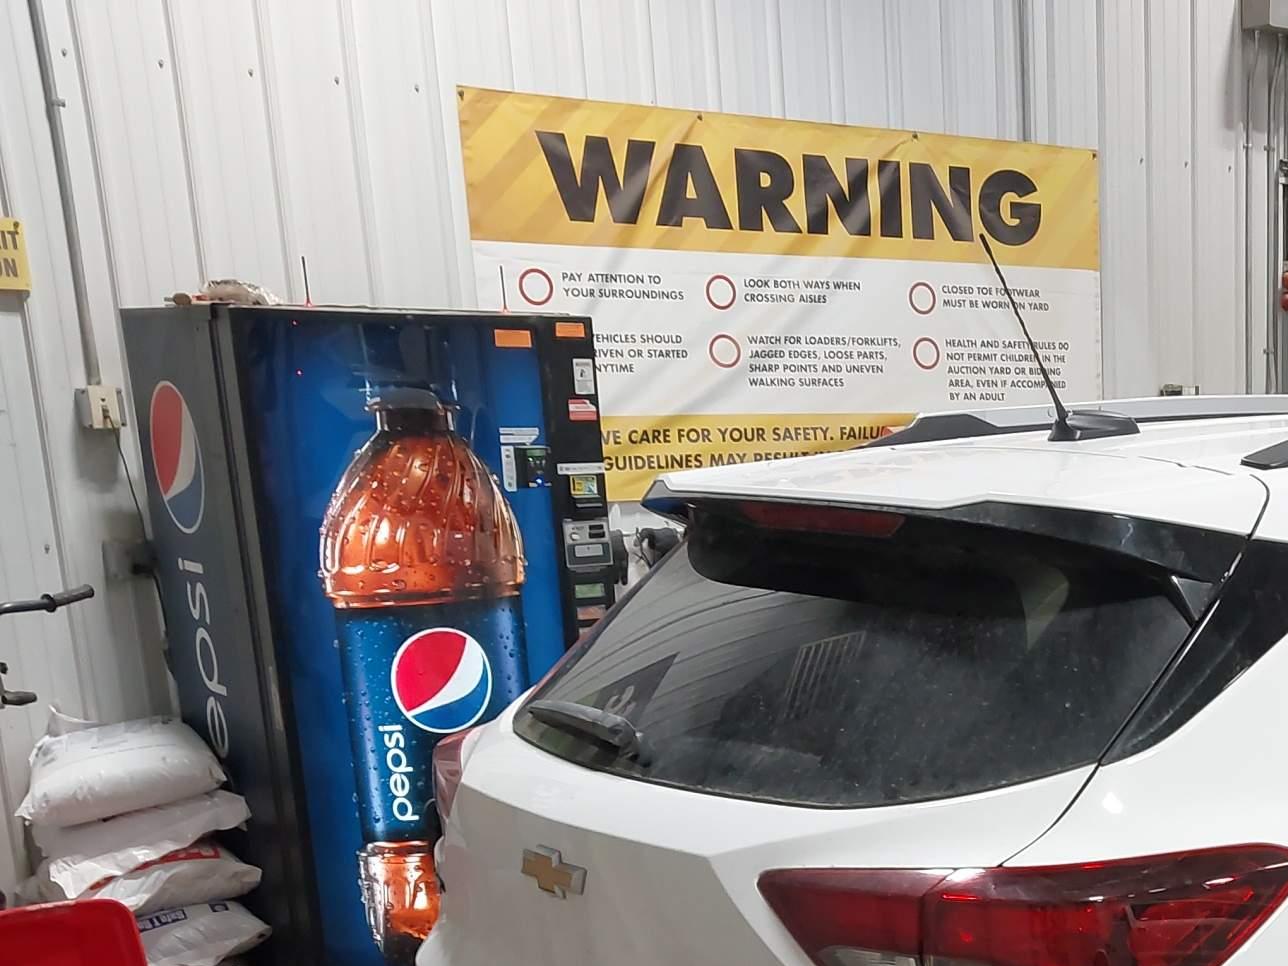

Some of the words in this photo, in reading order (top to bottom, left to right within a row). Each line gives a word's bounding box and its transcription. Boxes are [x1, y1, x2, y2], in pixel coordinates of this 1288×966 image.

[535, 130, 1043, 247] WARNING
[0, 230, 18, 250] IT
[562, 272, 583, 282] PAY
[588, 273, 645, 284] ATTENTION
[647, 275, 662, 285] TO
[743, 278, 770, 289] LOOK
[773, 279, 800, 289] BOTH
[802, 280, 831, 290] WAYS
[833, 281, 861, 291] WHEN
[563, 287, 596, 298] YOUR
[598, 288, 685, 300] SURROUNDINGS
[941, 285, 974, 295] CLOSED
[977, 286, 993, 296] TOE
[743, 293, 795, 304] CROSSING
[799, 294, 828, 304] AISLES
[942, 299, 967, 308] MUST
[969, 300, 979, 309] BE
[982, 300, 1010, 310] WORN
[1012, 301, 1025, 311] ON
[1028, 302, 1049, 311] YARD
[640, 334, 682, 344] SHOULD
[747, 336, 781, 345] WATCH
[784, 336, 802, 345] FOR
[804, 336, 901, 348] LOADERS/FORKLIFTS,
[945, 339, 977, 348] HEALTH
[980, 339, 999, 349] AND
[1001, 340, 1030, 350] SAFETY
[1032, 341, 1056, 350] RULES
[1058, 342, 1069, 351] DO
[594, 348, 624, 358] RIVEN
[627, 349, 644, 358] OR
[647, 349, 688, 359] STARTED
[749, 350, 785, 359] JAGGED
[788, 350, 821, 361] EDGES,
[824, 350, 854, 360] LOOSE
[857, 350, 888, 361] PARTS,
[946, 352, 965, 361] NOT
[967, 353, 997, 362] PERMIT
[1042, 355, 1051, 363] IN
[1053, 355, 1066, 364] THE
[594, 363, 635, 373] NYTIME
[749, 364, 780, 373] SHARP
[783, 364, 818, 373] POINTS
[821, 364, 843, 373] AND
[845, 364, 884, 374] UNEVEN
[947, 366, 986, 375] AUCTION
[988, 366, 1011, 375] YARD
[1014, 367, 1026, 376] OR
[1028, 367, 1061, 377] BIDING
[748, 377, 796, 387] WALKING
[798, 377, 845, 387] SURFACES
[948, 379, 973, 389] AREA,
[976, 379, 998, 388] EVEN
[1000, 379, 1007, 388] IF
[1010, 379, 1066, 389] ACCOMPNIED
[949, 392, 960, 401] BY
[963, 392, 976, 401] AN
[979, 392, 1005, 401] ADULT
[627, 429, 672, 445] CARE
[677, 428, 713, 443] FOR
[717, 427, 767, 443] YOUR
[772, 426, 834, 441] SAFETY.
[839, 425, 886, 441] FAILU
[604, 453, 703, 471] GUIDELINES
[709, 452, 748, 467] MAY
[177, 557, 229, 759] epsi
[378, 724, 420, 821] pepsi
